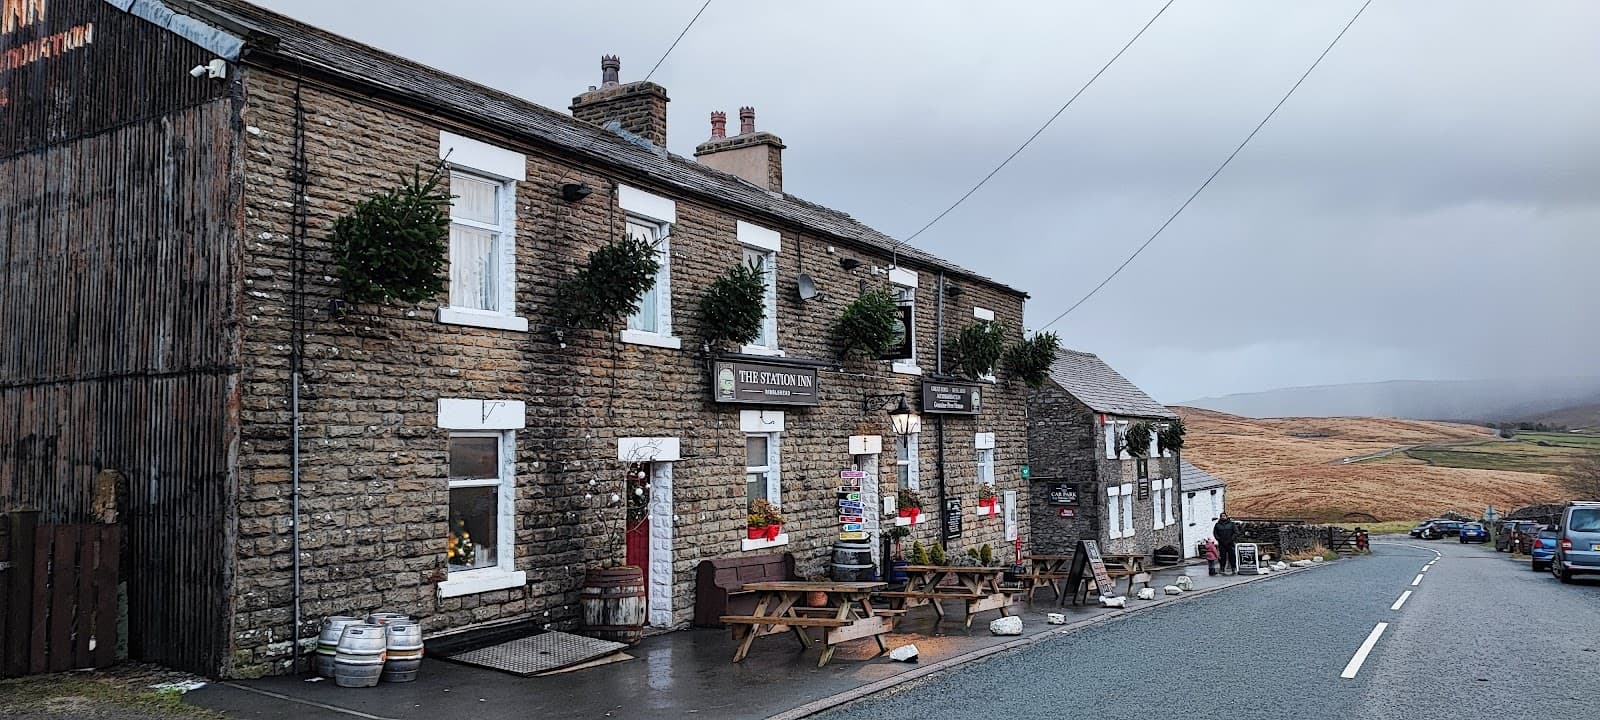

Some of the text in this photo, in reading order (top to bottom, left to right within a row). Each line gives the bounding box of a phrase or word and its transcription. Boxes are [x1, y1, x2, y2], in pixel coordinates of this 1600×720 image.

[739, 370, 812, 387] THE STATION INN
